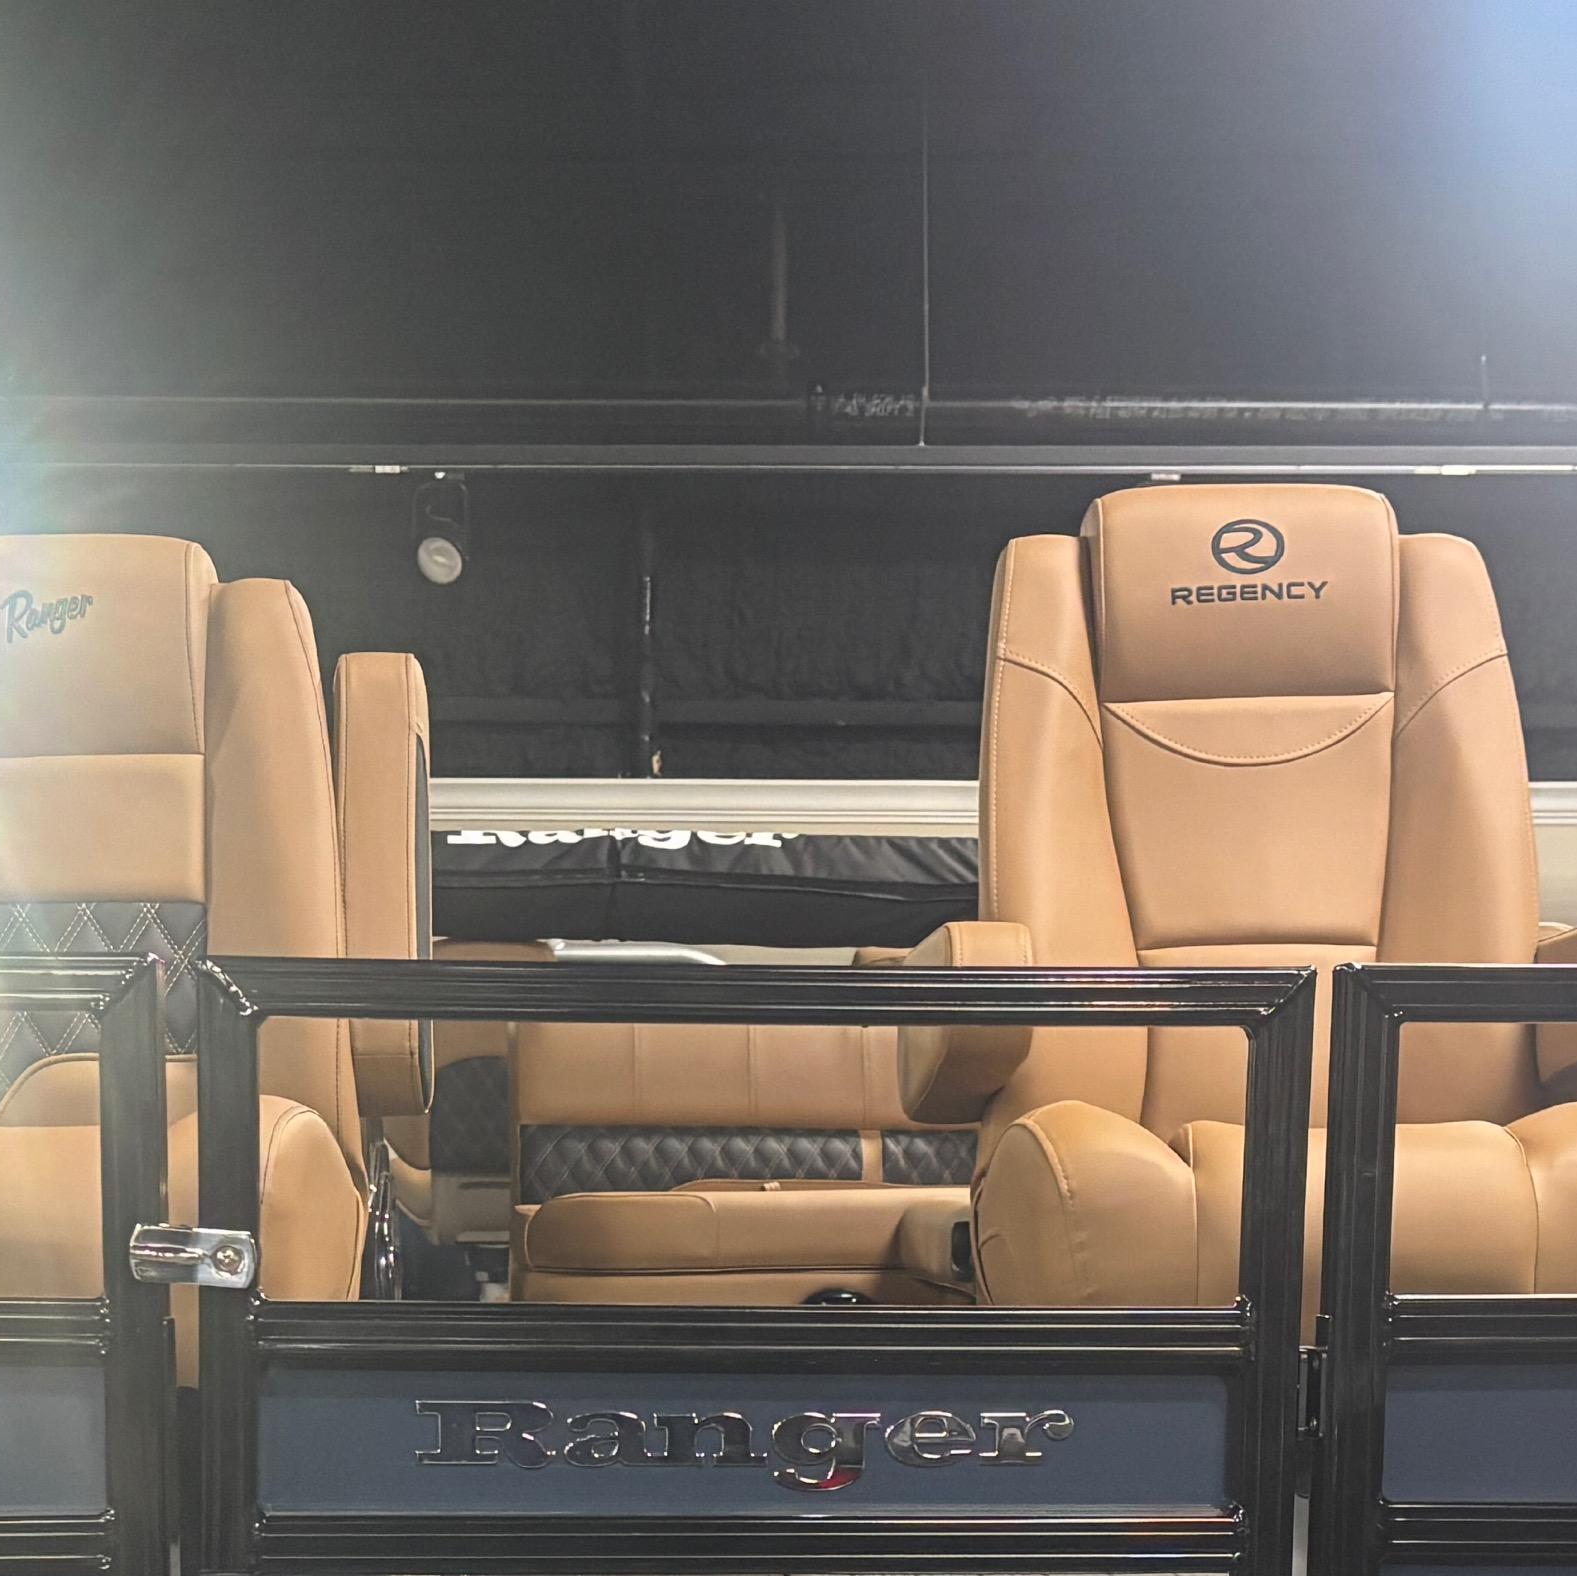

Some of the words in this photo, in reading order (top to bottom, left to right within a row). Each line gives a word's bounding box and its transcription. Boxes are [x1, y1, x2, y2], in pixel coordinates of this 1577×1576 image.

[0, 589, 95, 644] Ranger
[1170, 580, 1329, 606] REGENCY
[414, 1399, 1077, 1493] Ranger
